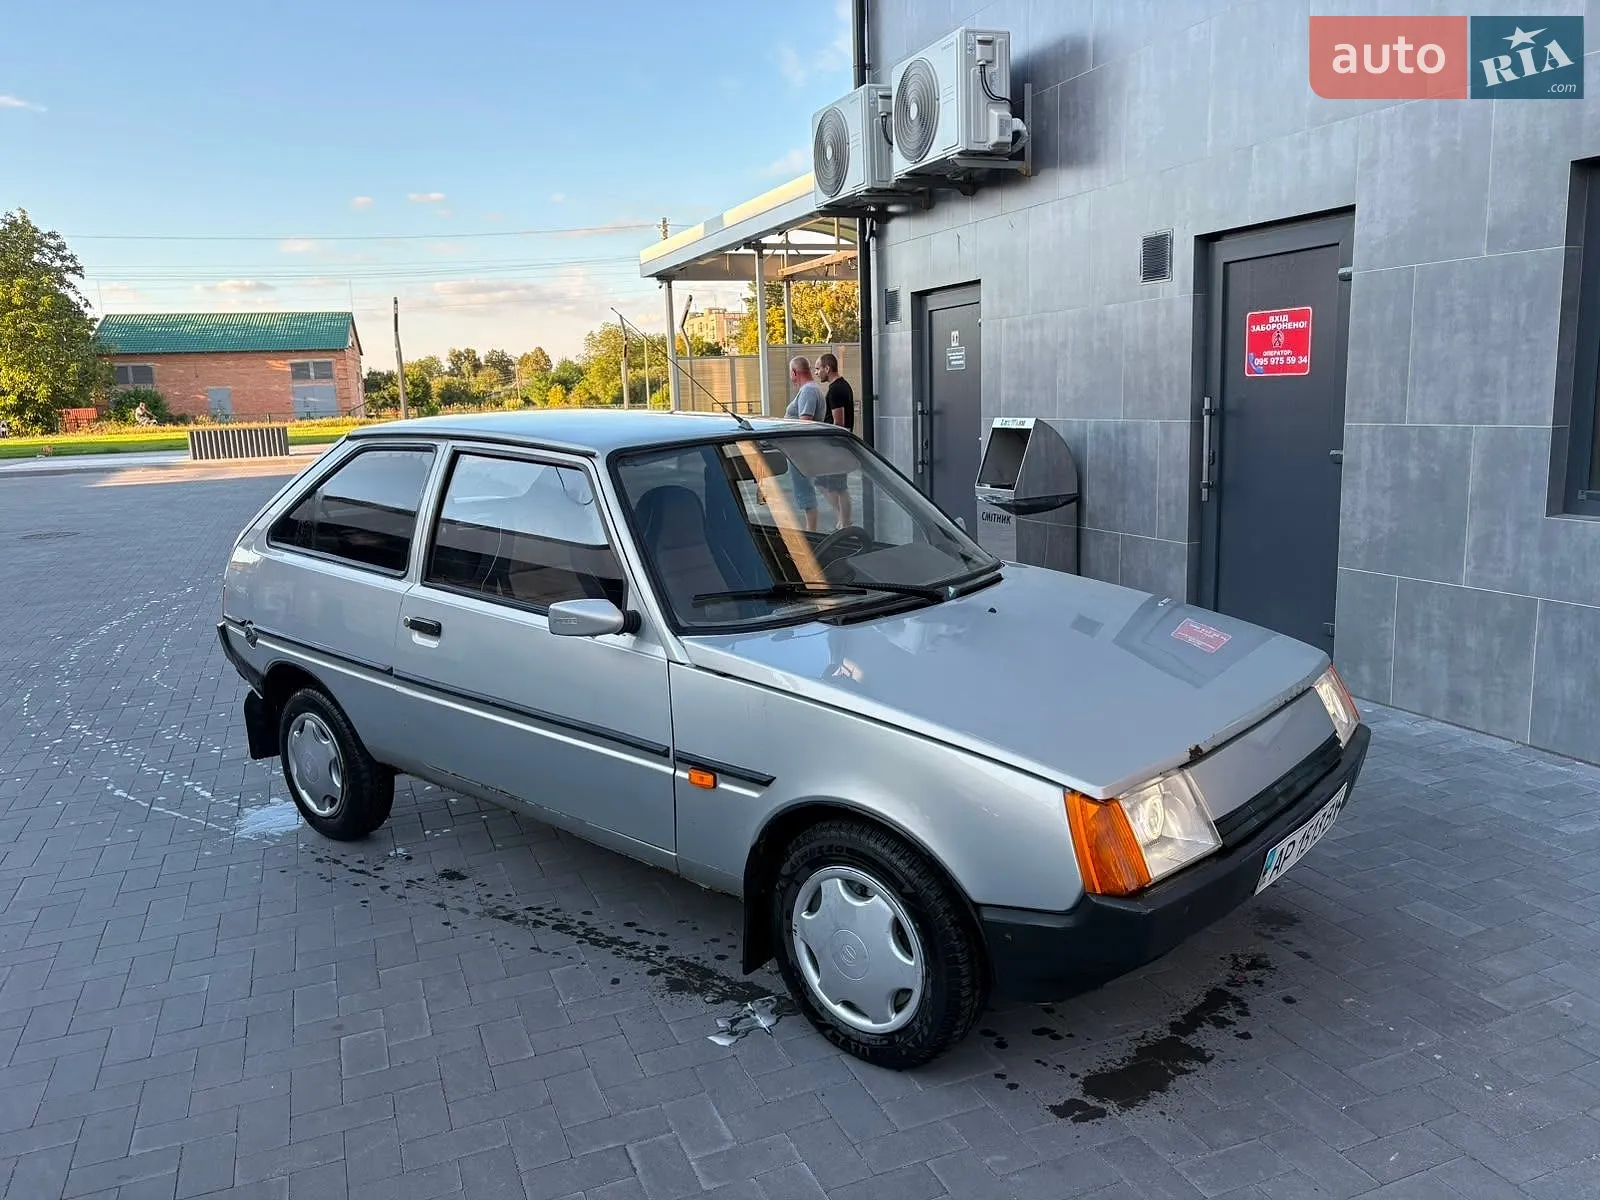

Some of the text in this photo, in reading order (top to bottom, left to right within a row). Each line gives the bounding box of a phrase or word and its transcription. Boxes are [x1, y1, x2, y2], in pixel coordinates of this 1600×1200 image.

[1269, 314, 1289, 323] ВХІД
[1251, 321, 1308, 332] ЗАБОРОНЕНО!
[1254, 355, 1308, 366] 095 975 59 34
[981, 511, 1012, 525] СМІТНИК
